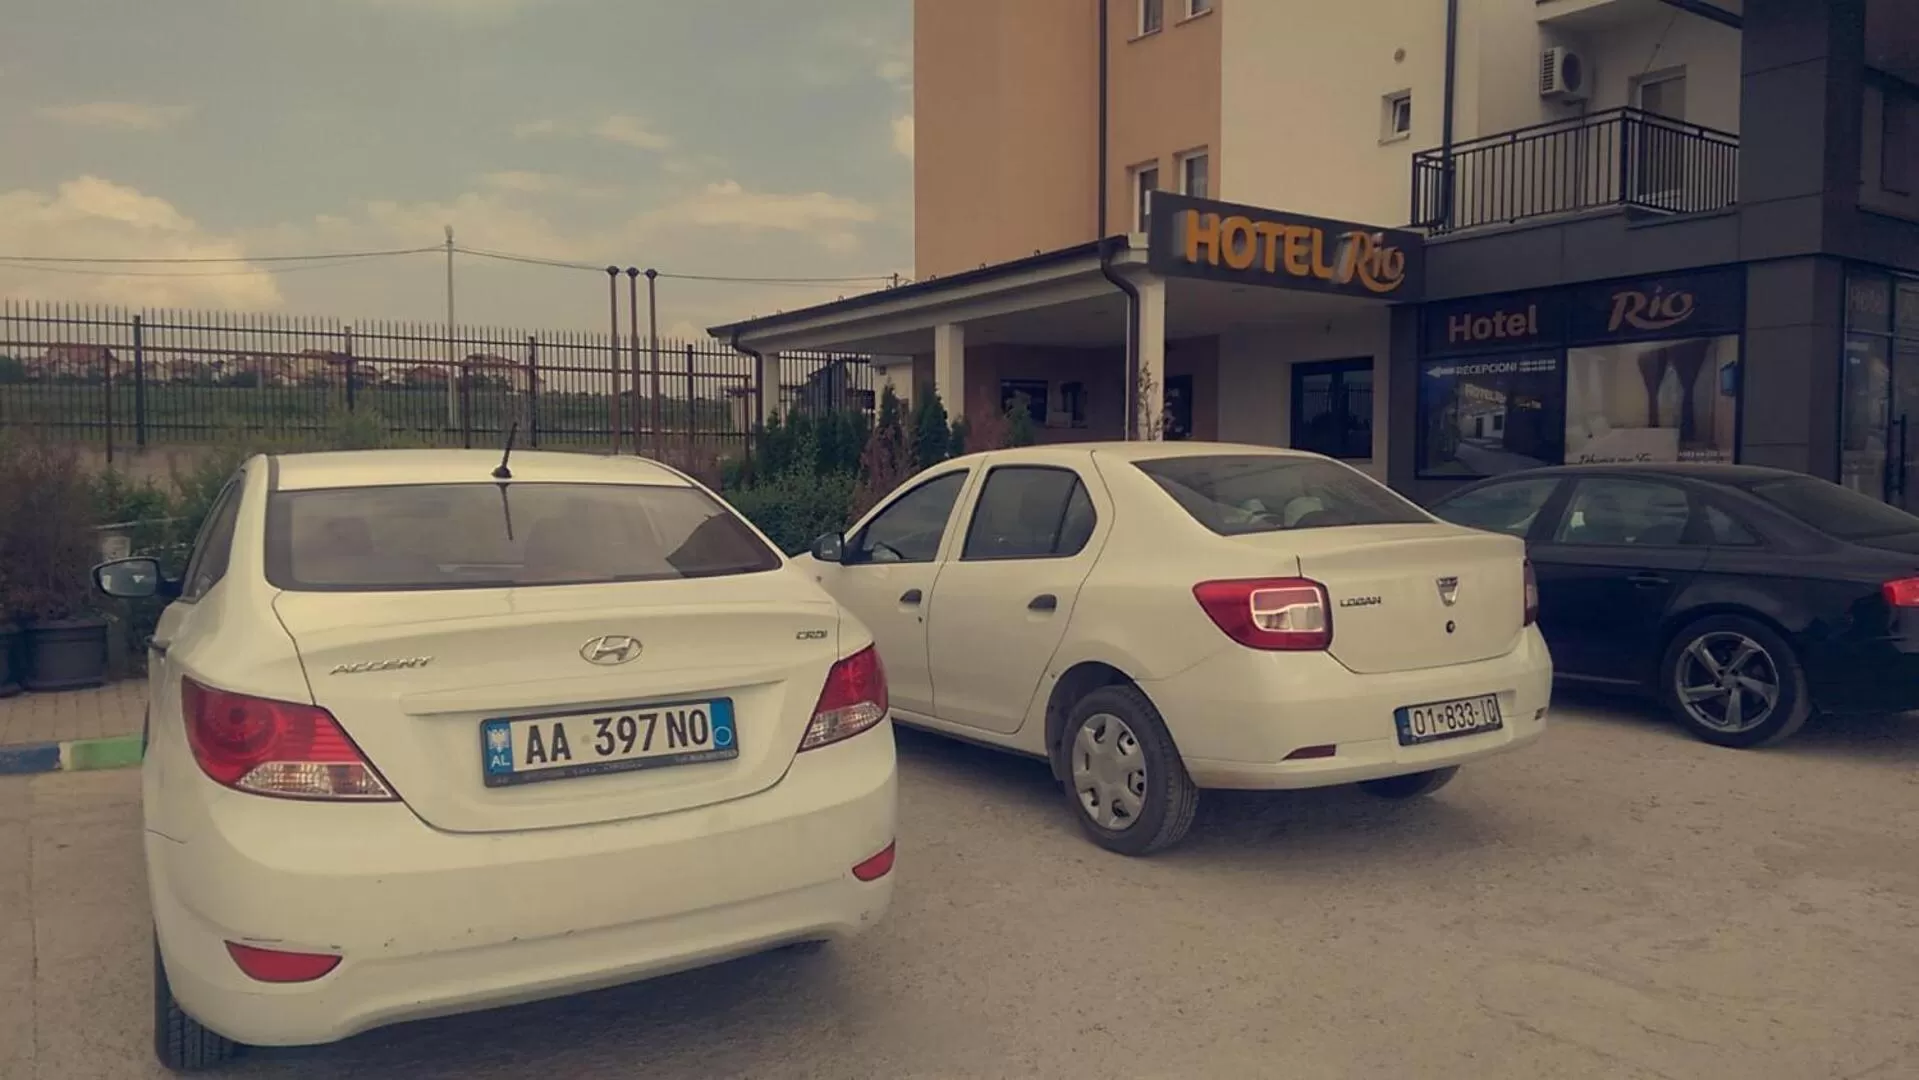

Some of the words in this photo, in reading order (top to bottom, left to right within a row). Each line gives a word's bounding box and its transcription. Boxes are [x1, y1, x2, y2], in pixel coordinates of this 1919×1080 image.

[1184, 209, 1334, 280] HOTEL
[1337, 230, 1405, 293] Rio
[1449, 304, 1538, 343] Hotel
[1608, 285, 1696, 332] Rio
[1340, 596, 1381, 607] LOGAN
[329, 655, 434, 676] ACCENT
[525, 722, 572, 765] AA
[593, 712, 658, 756] 397
[491, 754, 511, 767] AL
